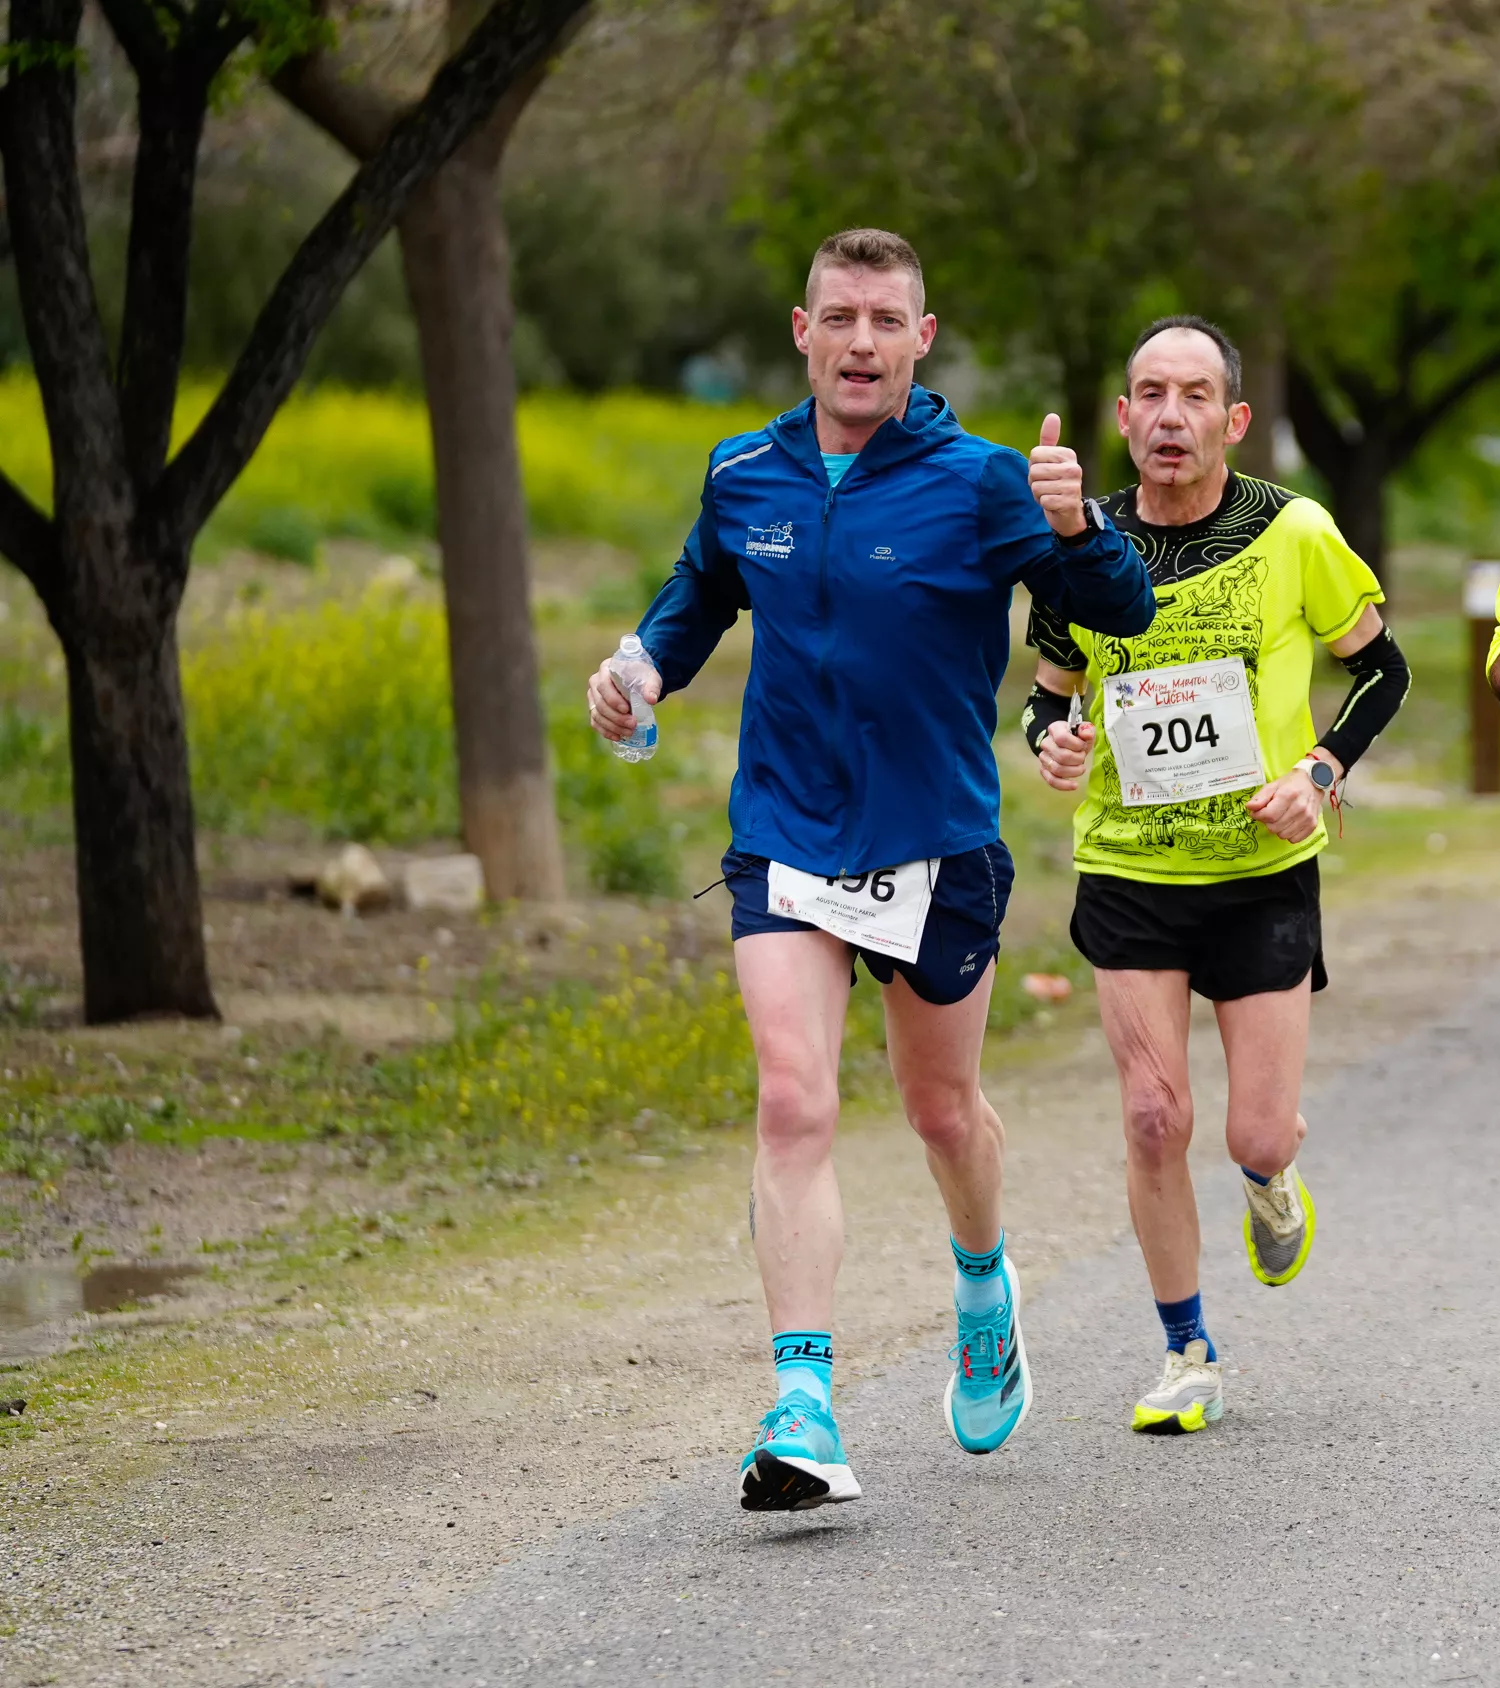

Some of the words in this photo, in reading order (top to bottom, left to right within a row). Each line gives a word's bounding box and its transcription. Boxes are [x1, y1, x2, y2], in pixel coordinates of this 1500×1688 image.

[1164, 621, 1188, 634] XVI
[1189, 620, 1238, 631] CARRERA
[1155, 690, 1201, 706] LUCENA
[1141, 713, 1220, 757] 204
[1144, 766, 1167, 774] ANTONIO
[1211, 755, 1230, 764] OTERO
[839, 903, 858, 913] LORITE
[858, 908, 877, 919] PARTAL
